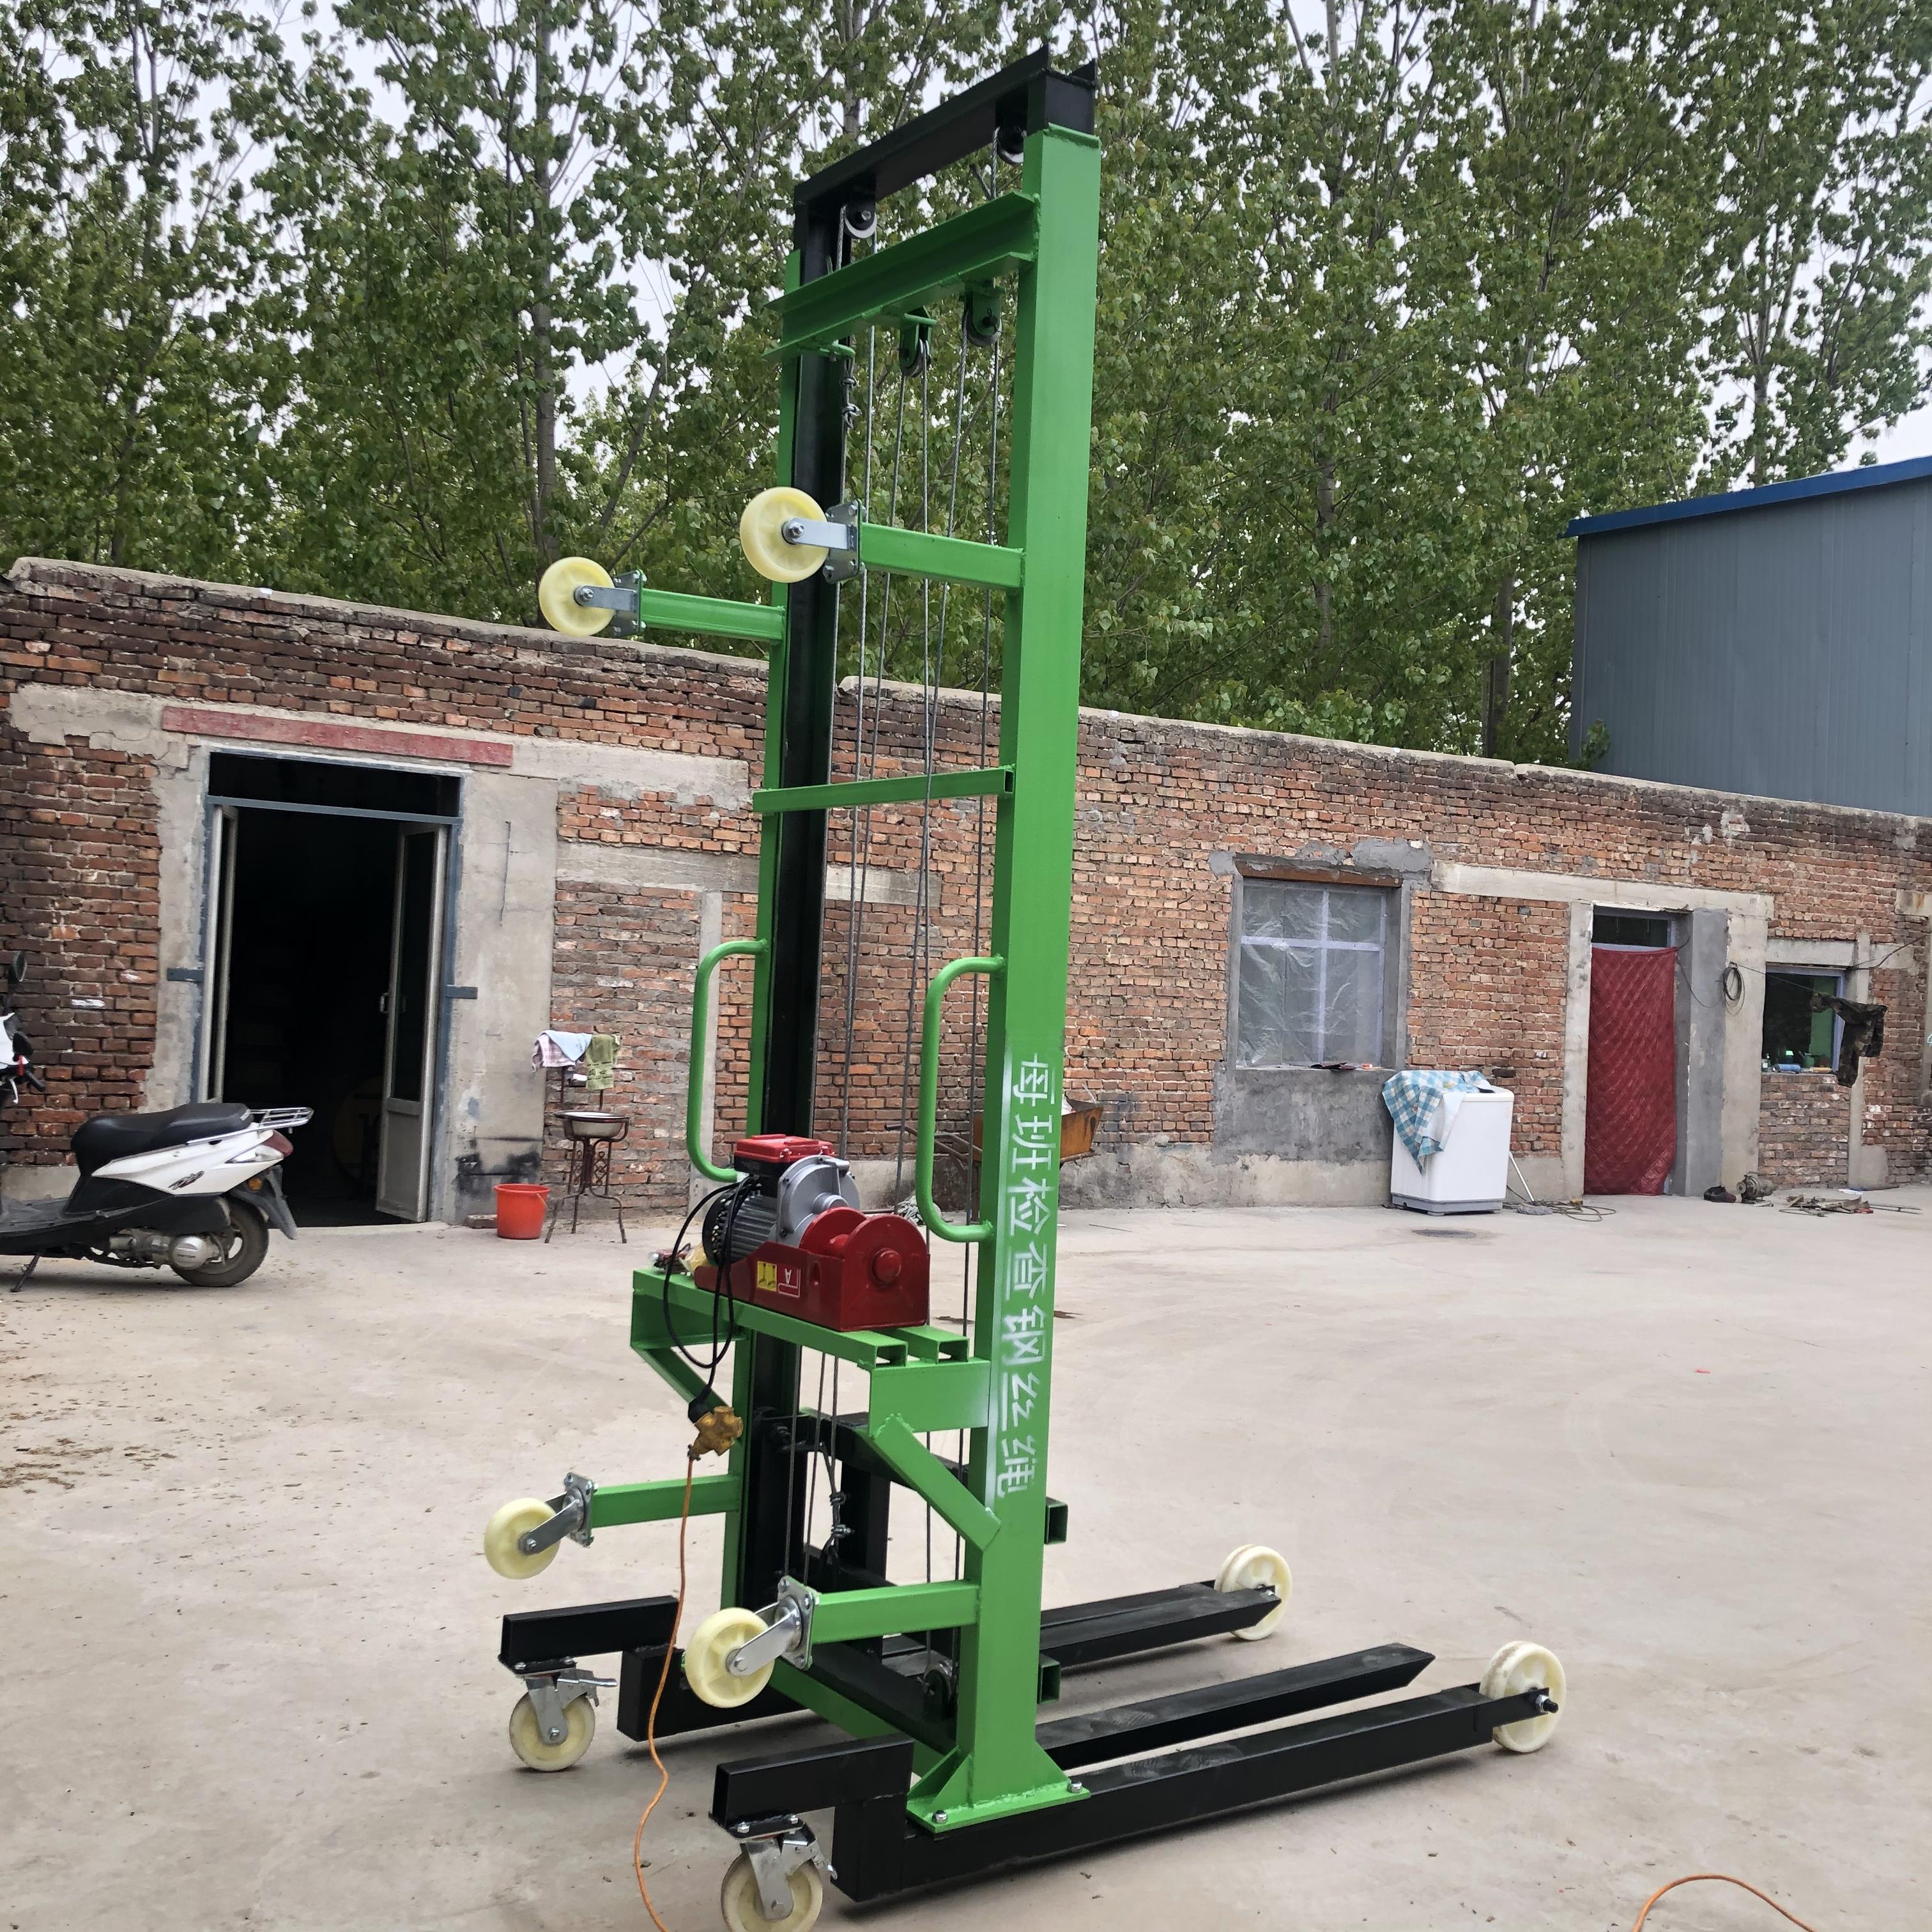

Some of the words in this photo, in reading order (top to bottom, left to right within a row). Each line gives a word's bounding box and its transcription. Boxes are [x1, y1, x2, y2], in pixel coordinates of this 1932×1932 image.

[997, 1053, 1057, 1498] 每班检查钢丝绳
